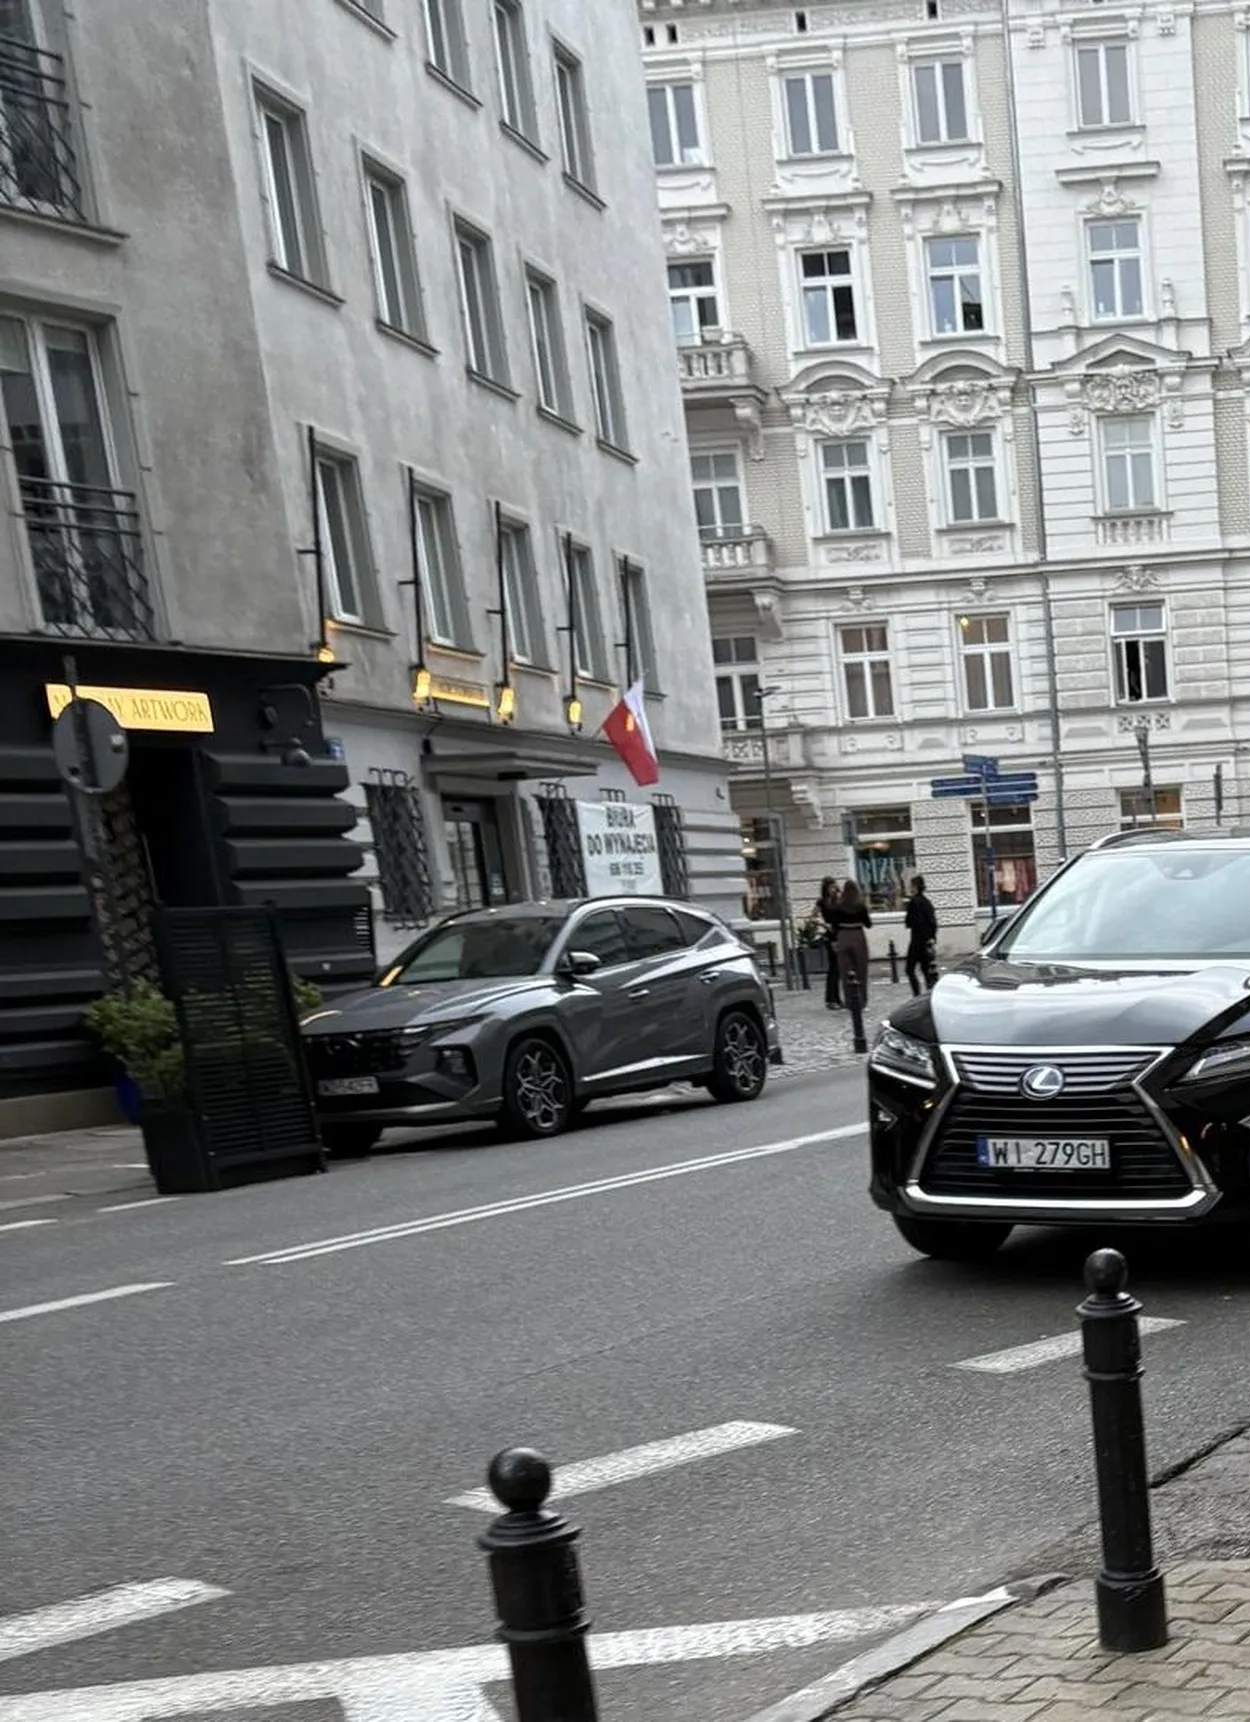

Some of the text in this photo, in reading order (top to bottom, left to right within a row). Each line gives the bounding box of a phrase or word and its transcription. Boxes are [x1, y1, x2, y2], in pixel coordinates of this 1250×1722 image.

[586, 833, 602, 855] DO
[992, 1141, 1107, 1166] WI 279GH
